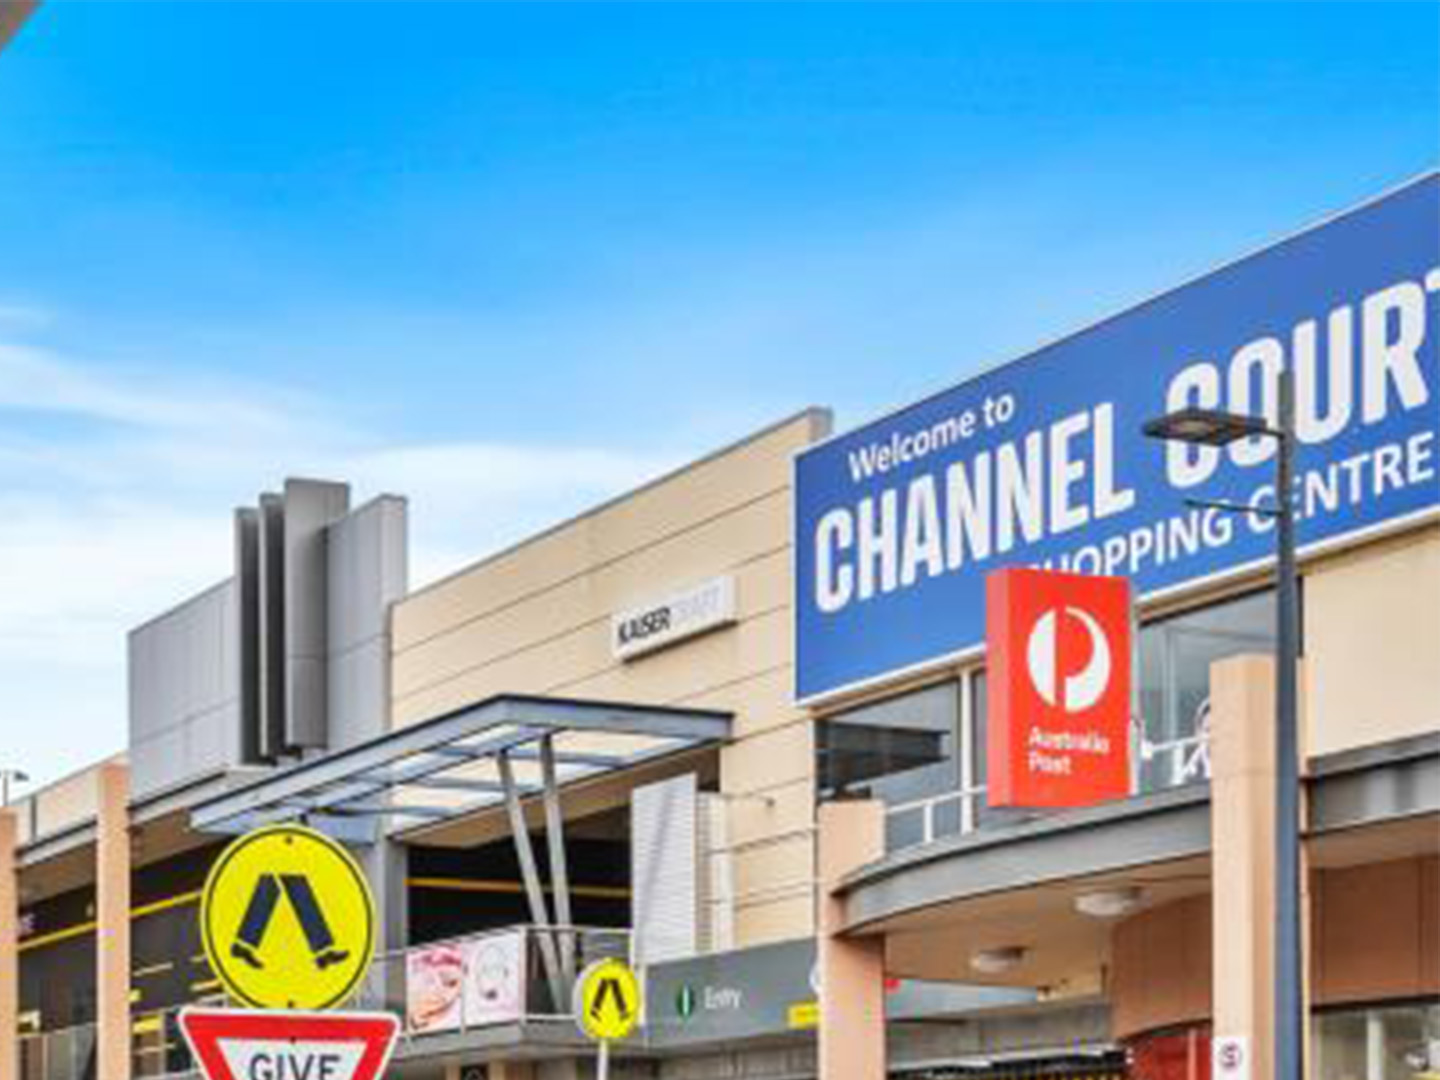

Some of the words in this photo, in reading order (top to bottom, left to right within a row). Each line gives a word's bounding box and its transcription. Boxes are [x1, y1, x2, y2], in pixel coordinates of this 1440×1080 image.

[814, 403, 1135, 614] CHANNEL
[1165, 268, 1440, 489] COUR
[848, 410, 976, 484] Welcome
[983, 394, 1015, 429] to
[1030, 500, 1234, 575] OPPING
[1247, 431, 1435, 536] CNTRE
[1028, 726, 1110, 755] Australia
[1028, 750, 1071, 775] Post
